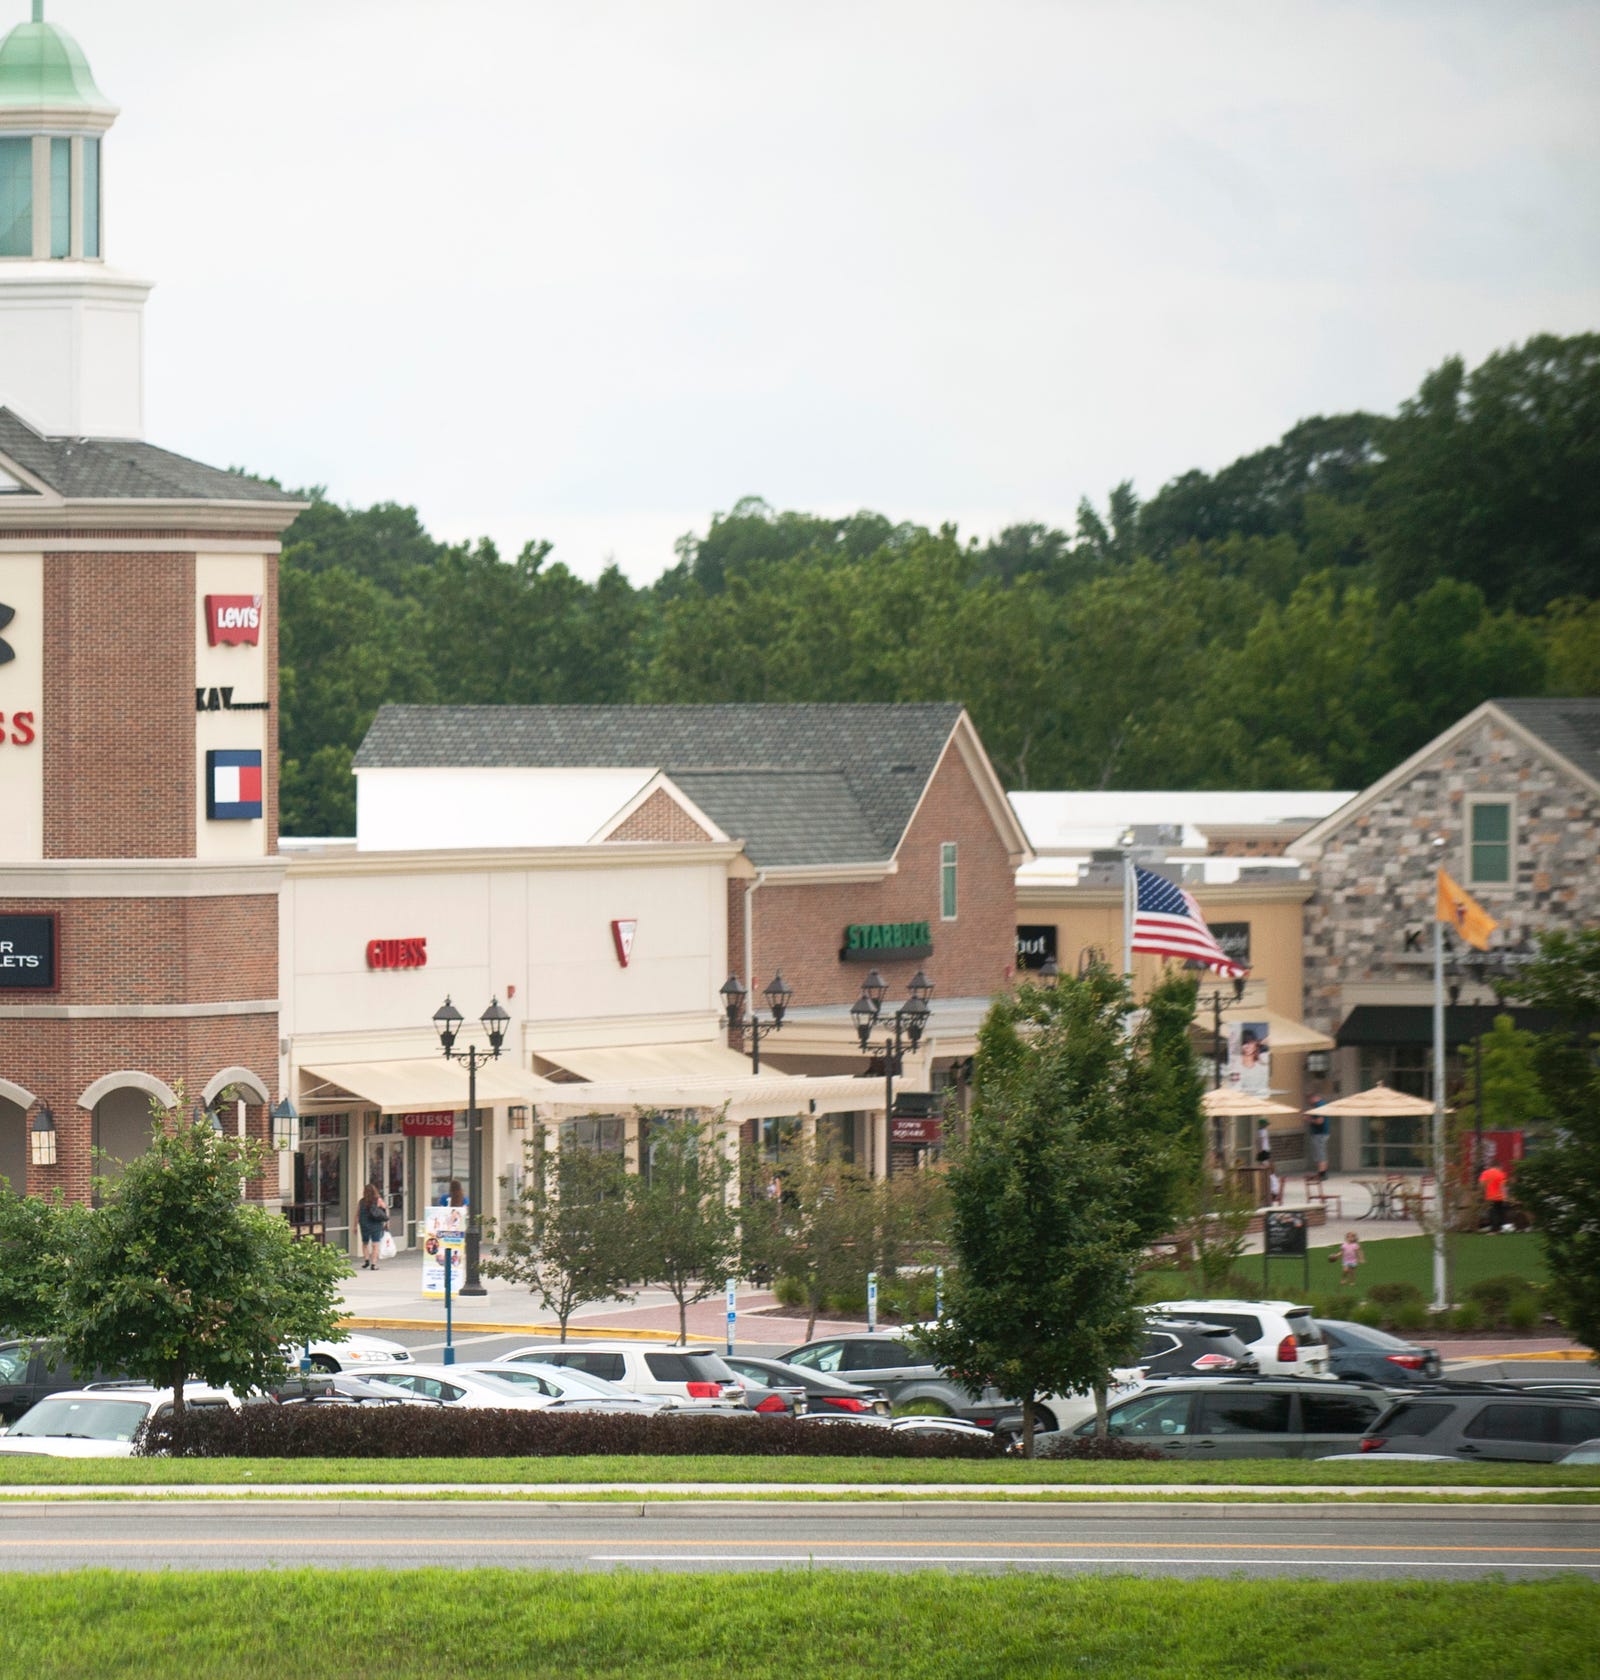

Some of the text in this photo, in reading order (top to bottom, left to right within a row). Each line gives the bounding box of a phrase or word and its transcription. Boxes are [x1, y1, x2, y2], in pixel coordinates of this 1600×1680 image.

[196, 686, 233, 711] KAY
[367, 938, 427, 968] GUESS
[404, 1114, 452, 1126] GUESS
